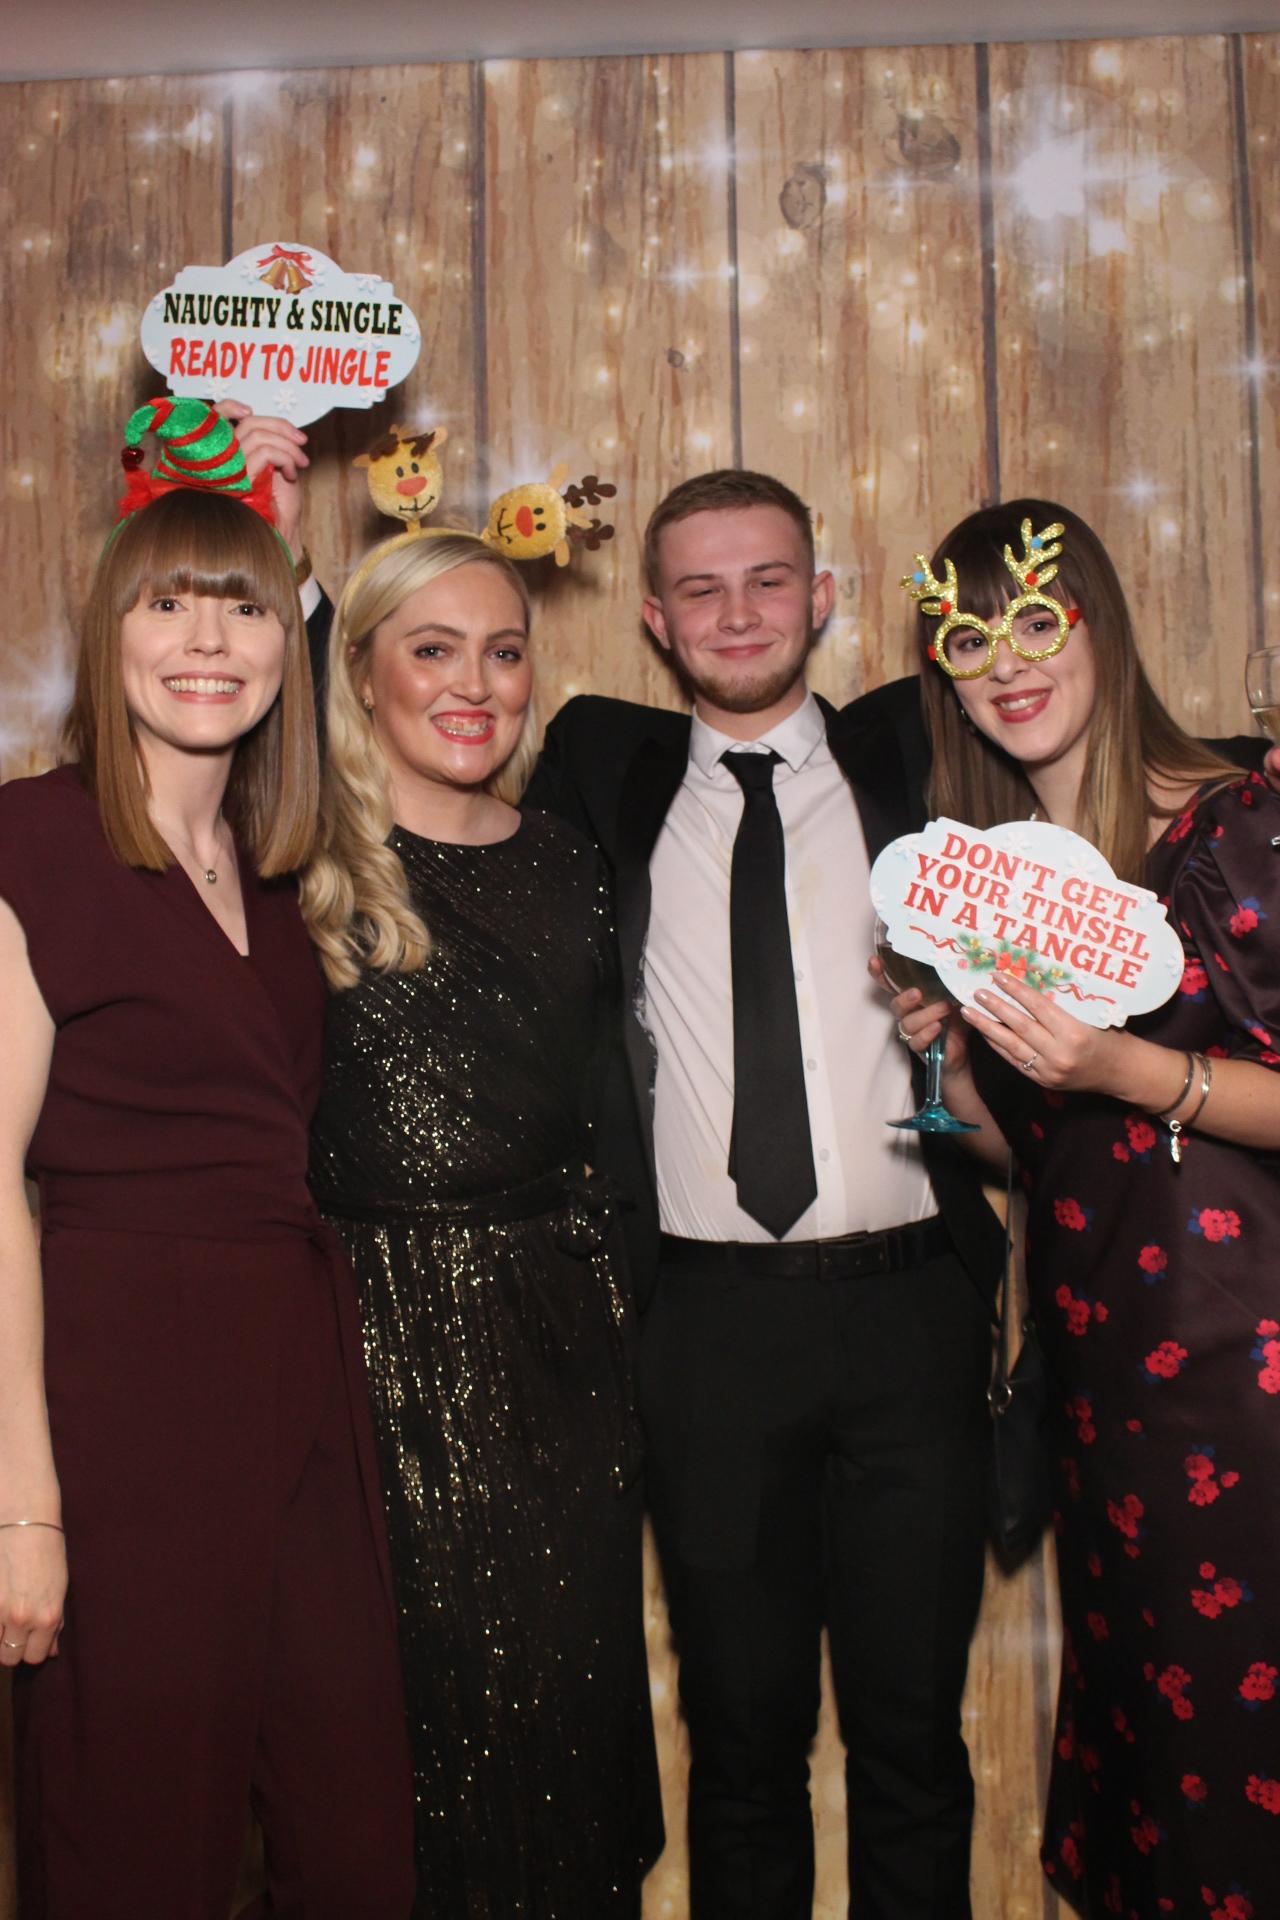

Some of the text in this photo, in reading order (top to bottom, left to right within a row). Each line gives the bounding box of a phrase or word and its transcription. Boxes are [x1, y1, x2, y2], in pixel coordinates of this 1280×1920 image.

[163, 293, 403, 335] NAUGHTY & SINGLE
[169, 338, 391, 387] READY TO JINGLE
[916, 853, 1150, 961] YOUR TINSEL
[940, 833, 1137, 921] DON'T GET
[903, 882, 1143, 989] IN A TANGLE
